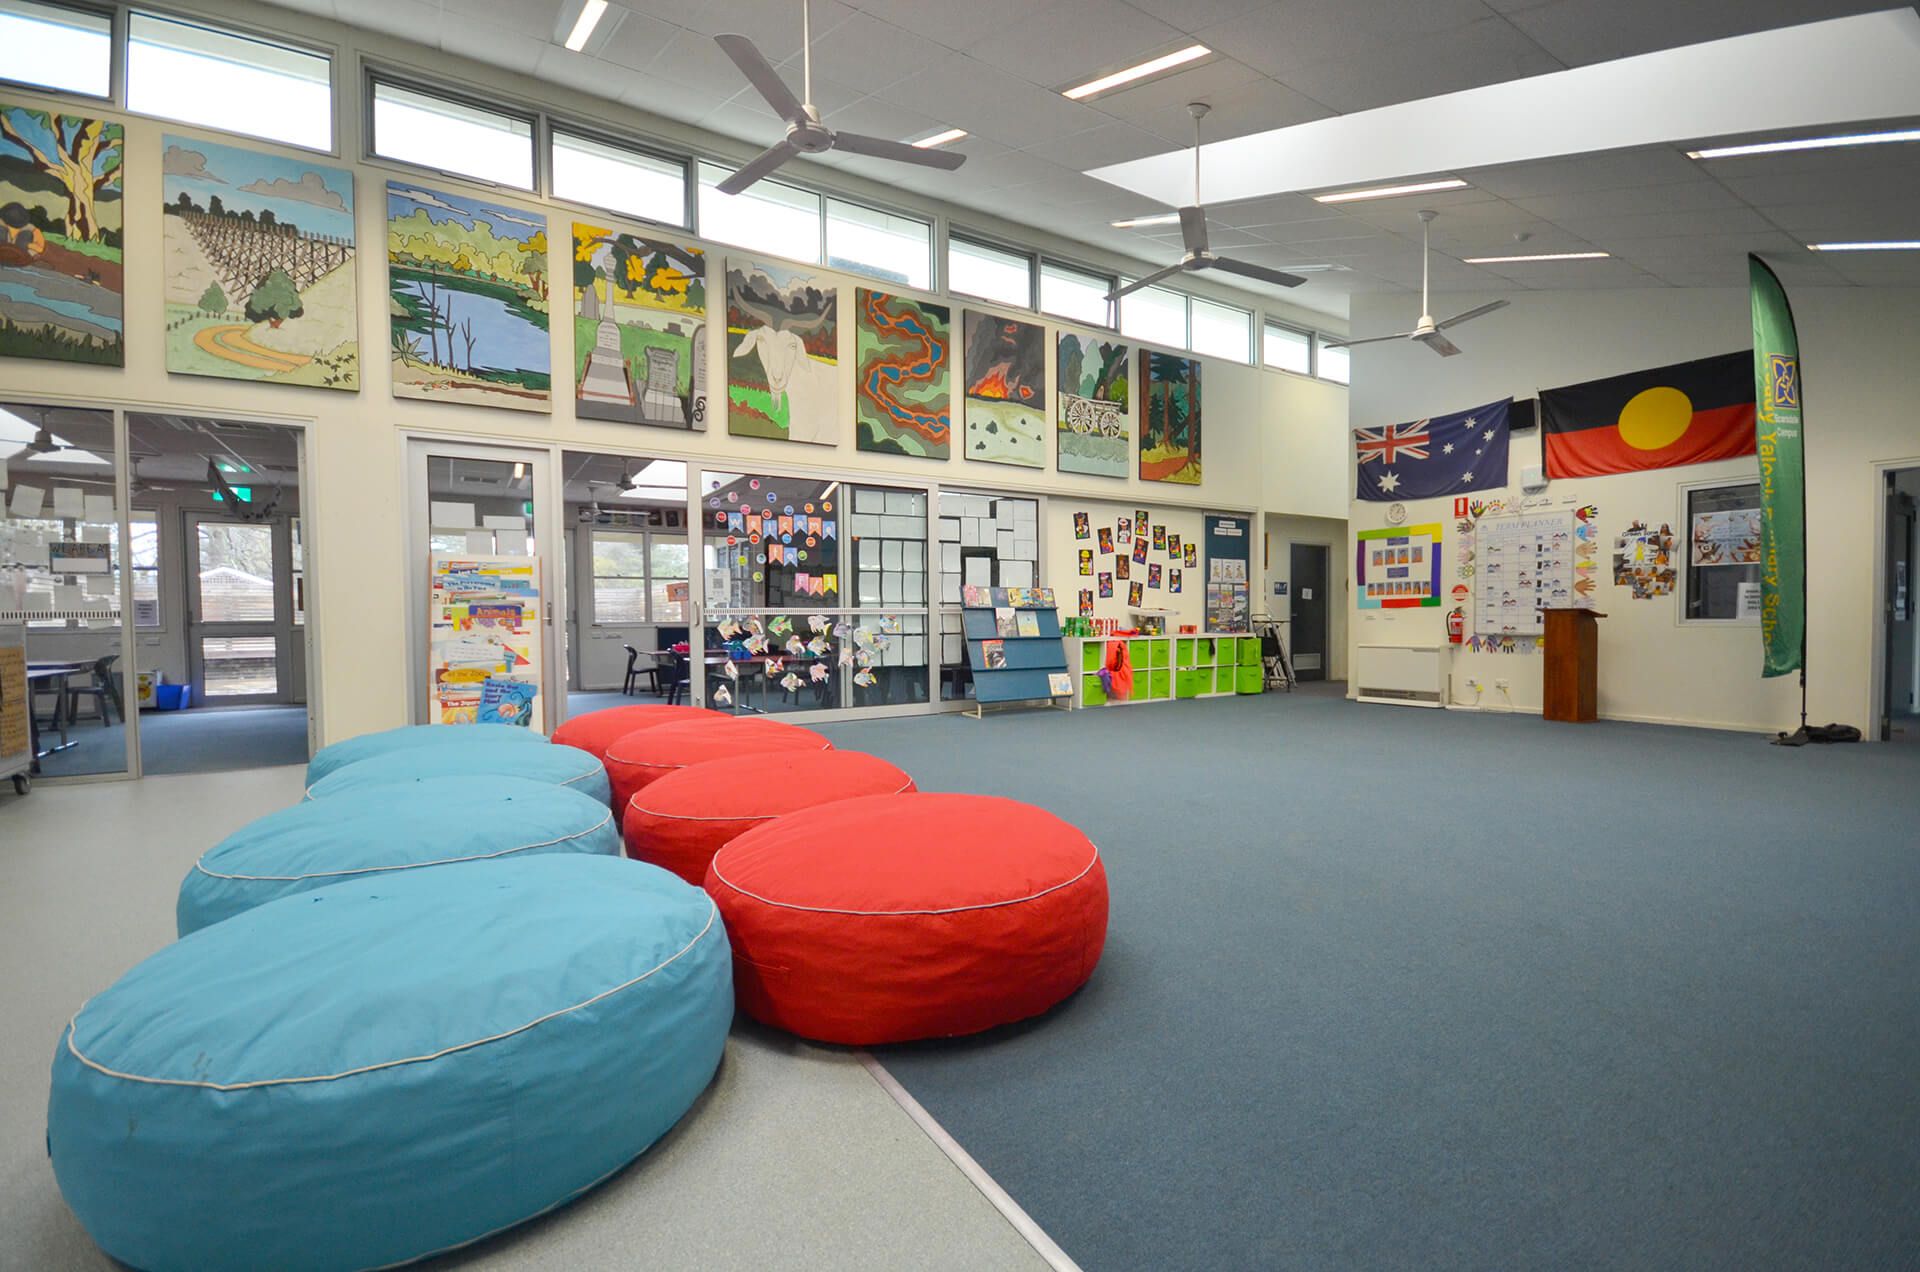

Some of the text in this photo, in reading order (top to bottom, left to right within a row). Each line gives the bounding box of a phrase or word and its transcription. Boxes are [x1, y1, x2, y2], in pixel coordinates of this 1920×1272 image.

[1776, 426, 1798, 439] Campus
[1522, 517, 1564, 530] PLANNER
[71, 543, 95, 553] ARE
[1762, 593, 1780, 660] Scho
